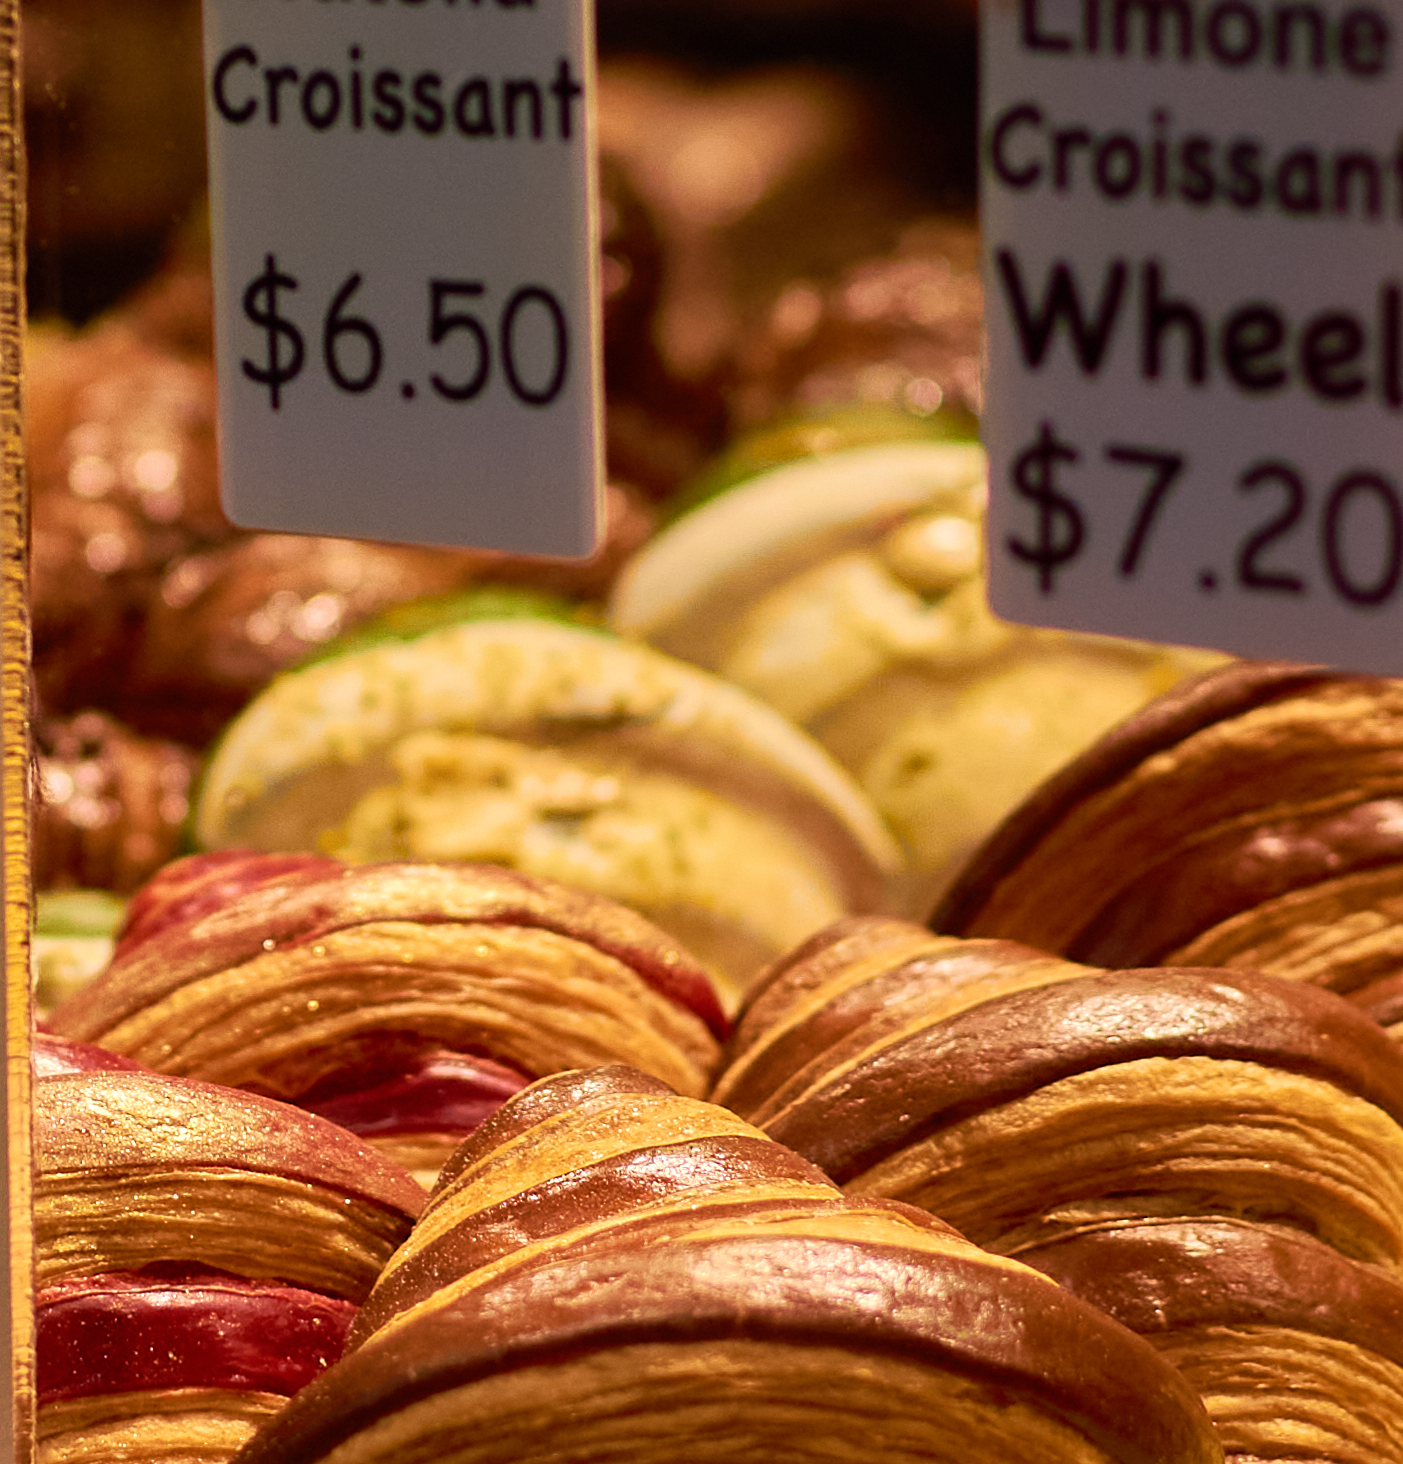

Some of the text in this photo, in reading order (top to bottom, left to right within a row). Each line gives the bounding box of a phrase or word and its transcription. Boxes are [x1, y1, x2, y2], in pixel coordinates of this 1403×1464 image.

[211, 44, 584, 142] Croissant
[986, 103, 1403, 222] Croissan
[240, 253, 570, 411] $6.50
[995, 243, 1403, 412] Wheel
[1005, 419, 1403, 612] $7.20
